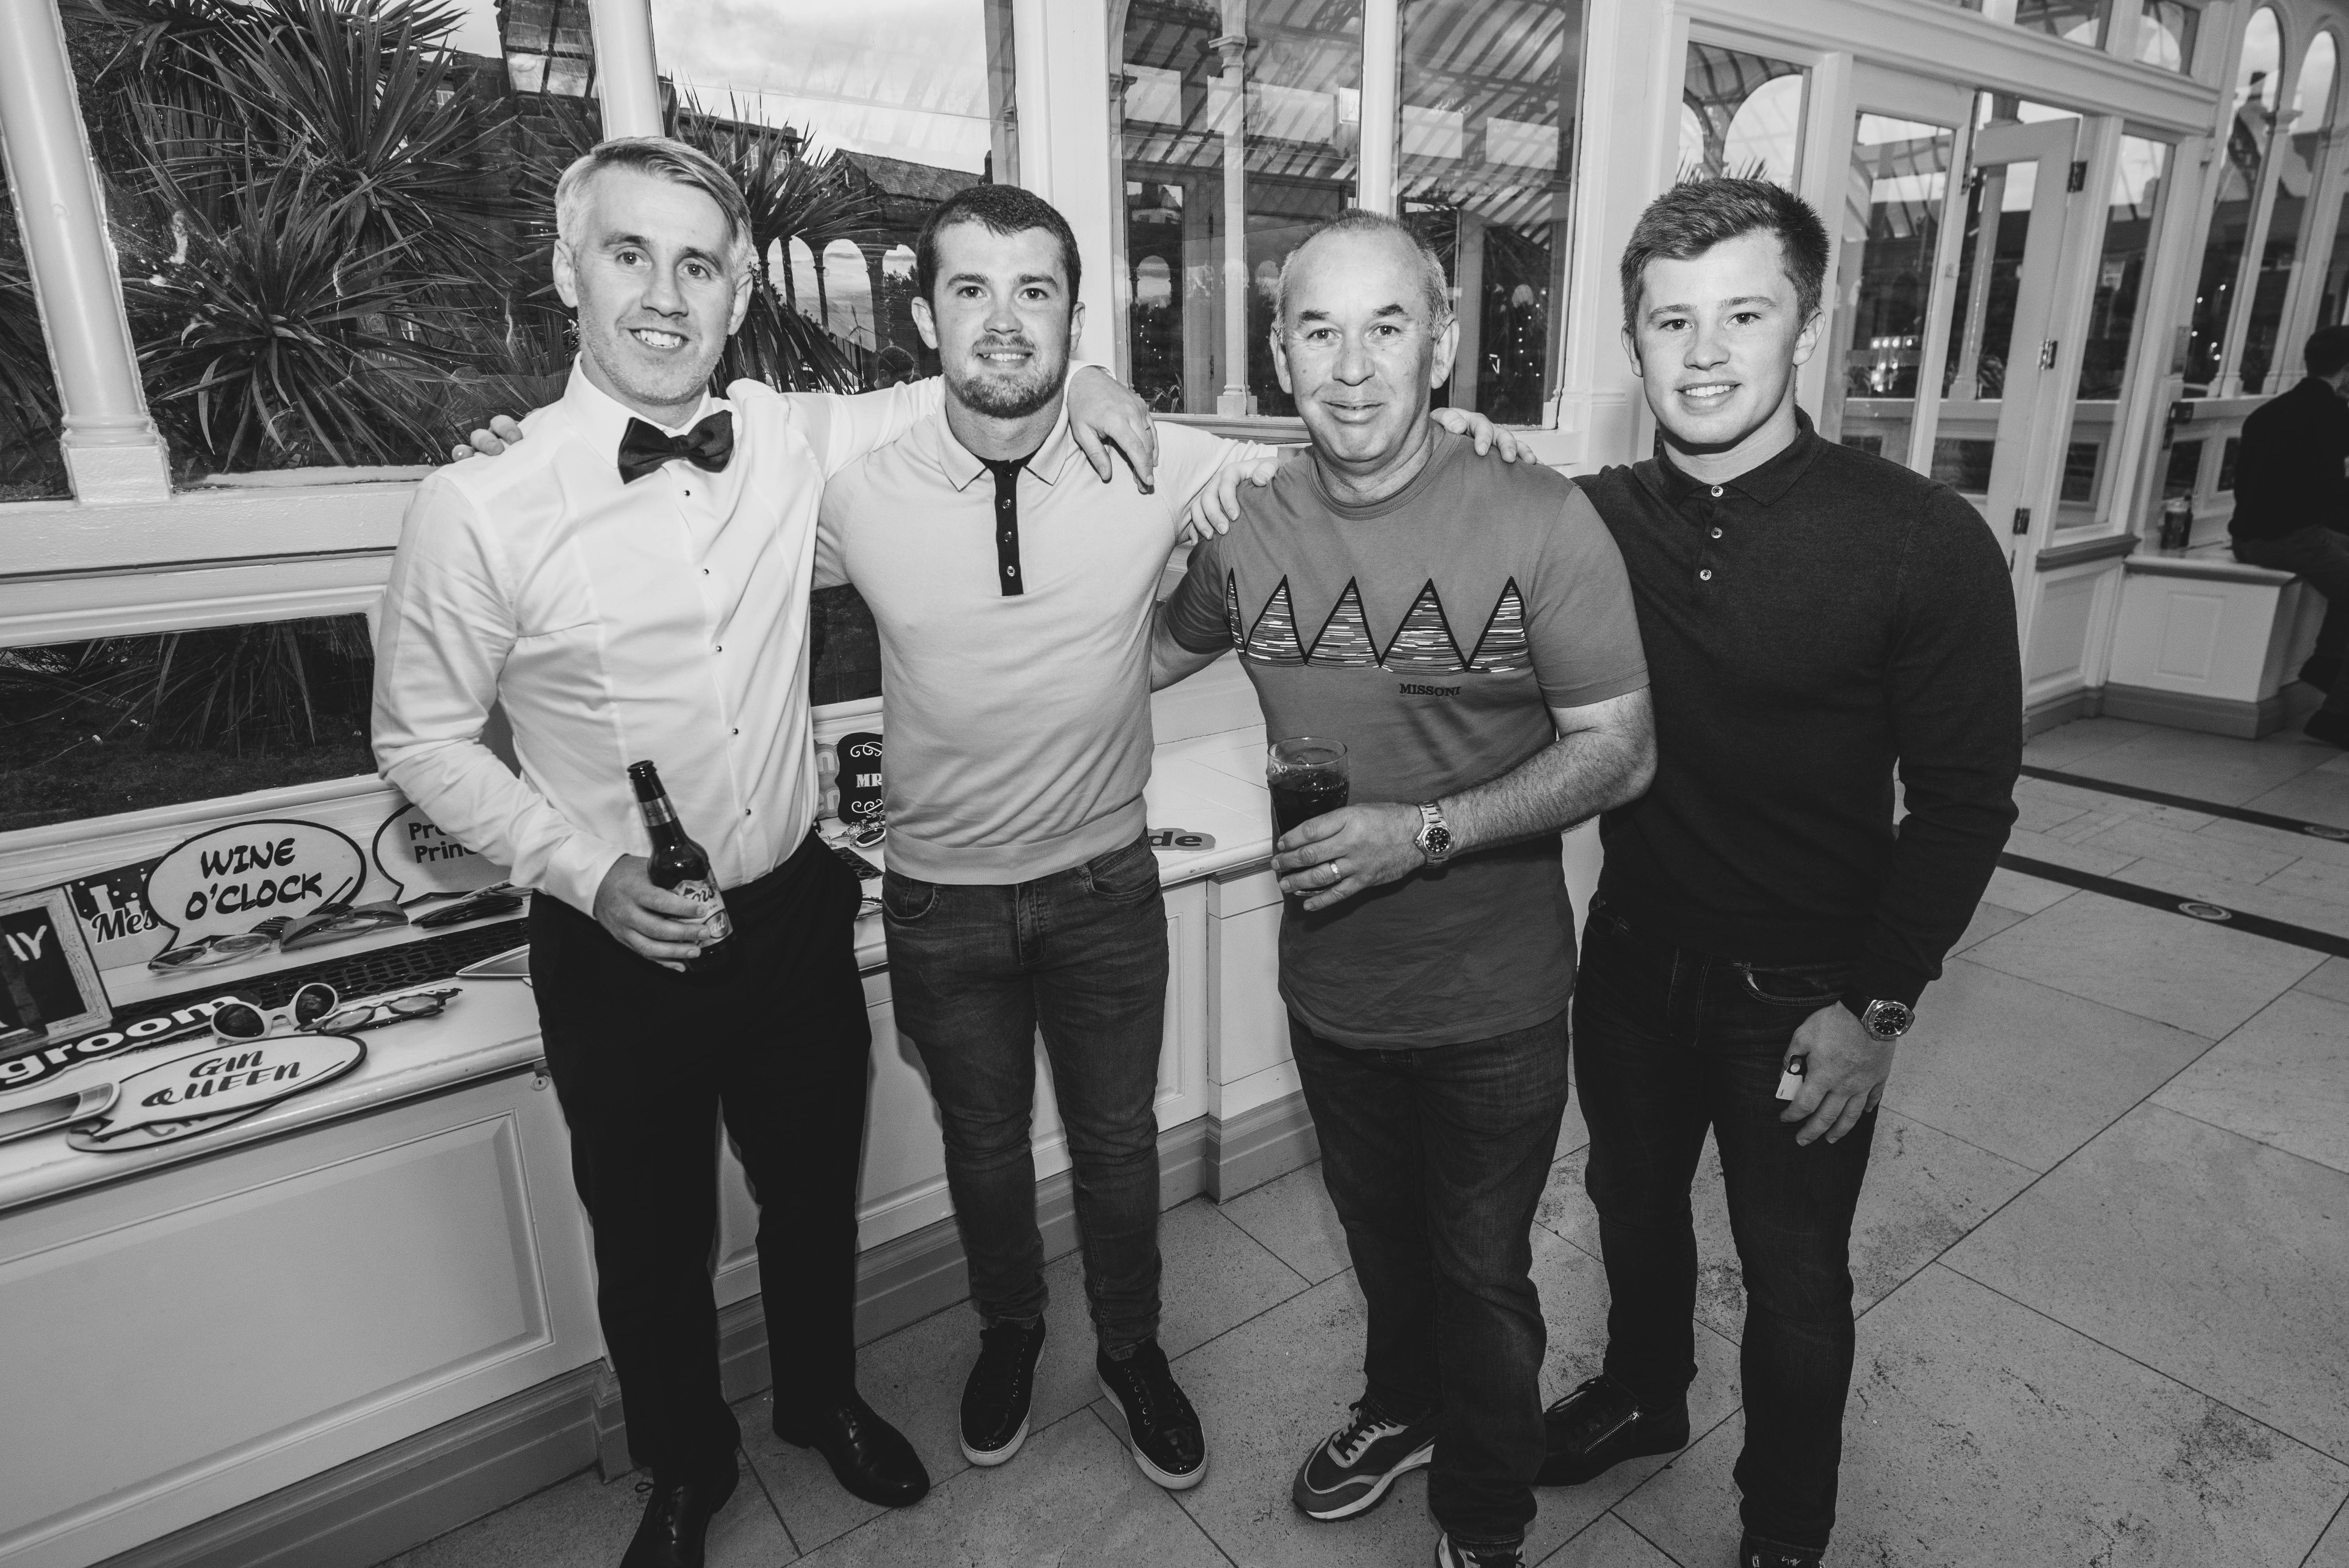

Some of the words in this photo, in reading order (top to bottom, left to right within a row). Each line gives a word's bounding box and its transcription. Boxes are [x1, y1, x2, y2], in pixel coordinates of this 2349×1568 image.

[1399, 683, 1461, 696] MISSONI
[856, 773, 882, 788] MR
[201, 838, 296, 879] WINE
[185, 872, 322, 920] O'CLOCK
